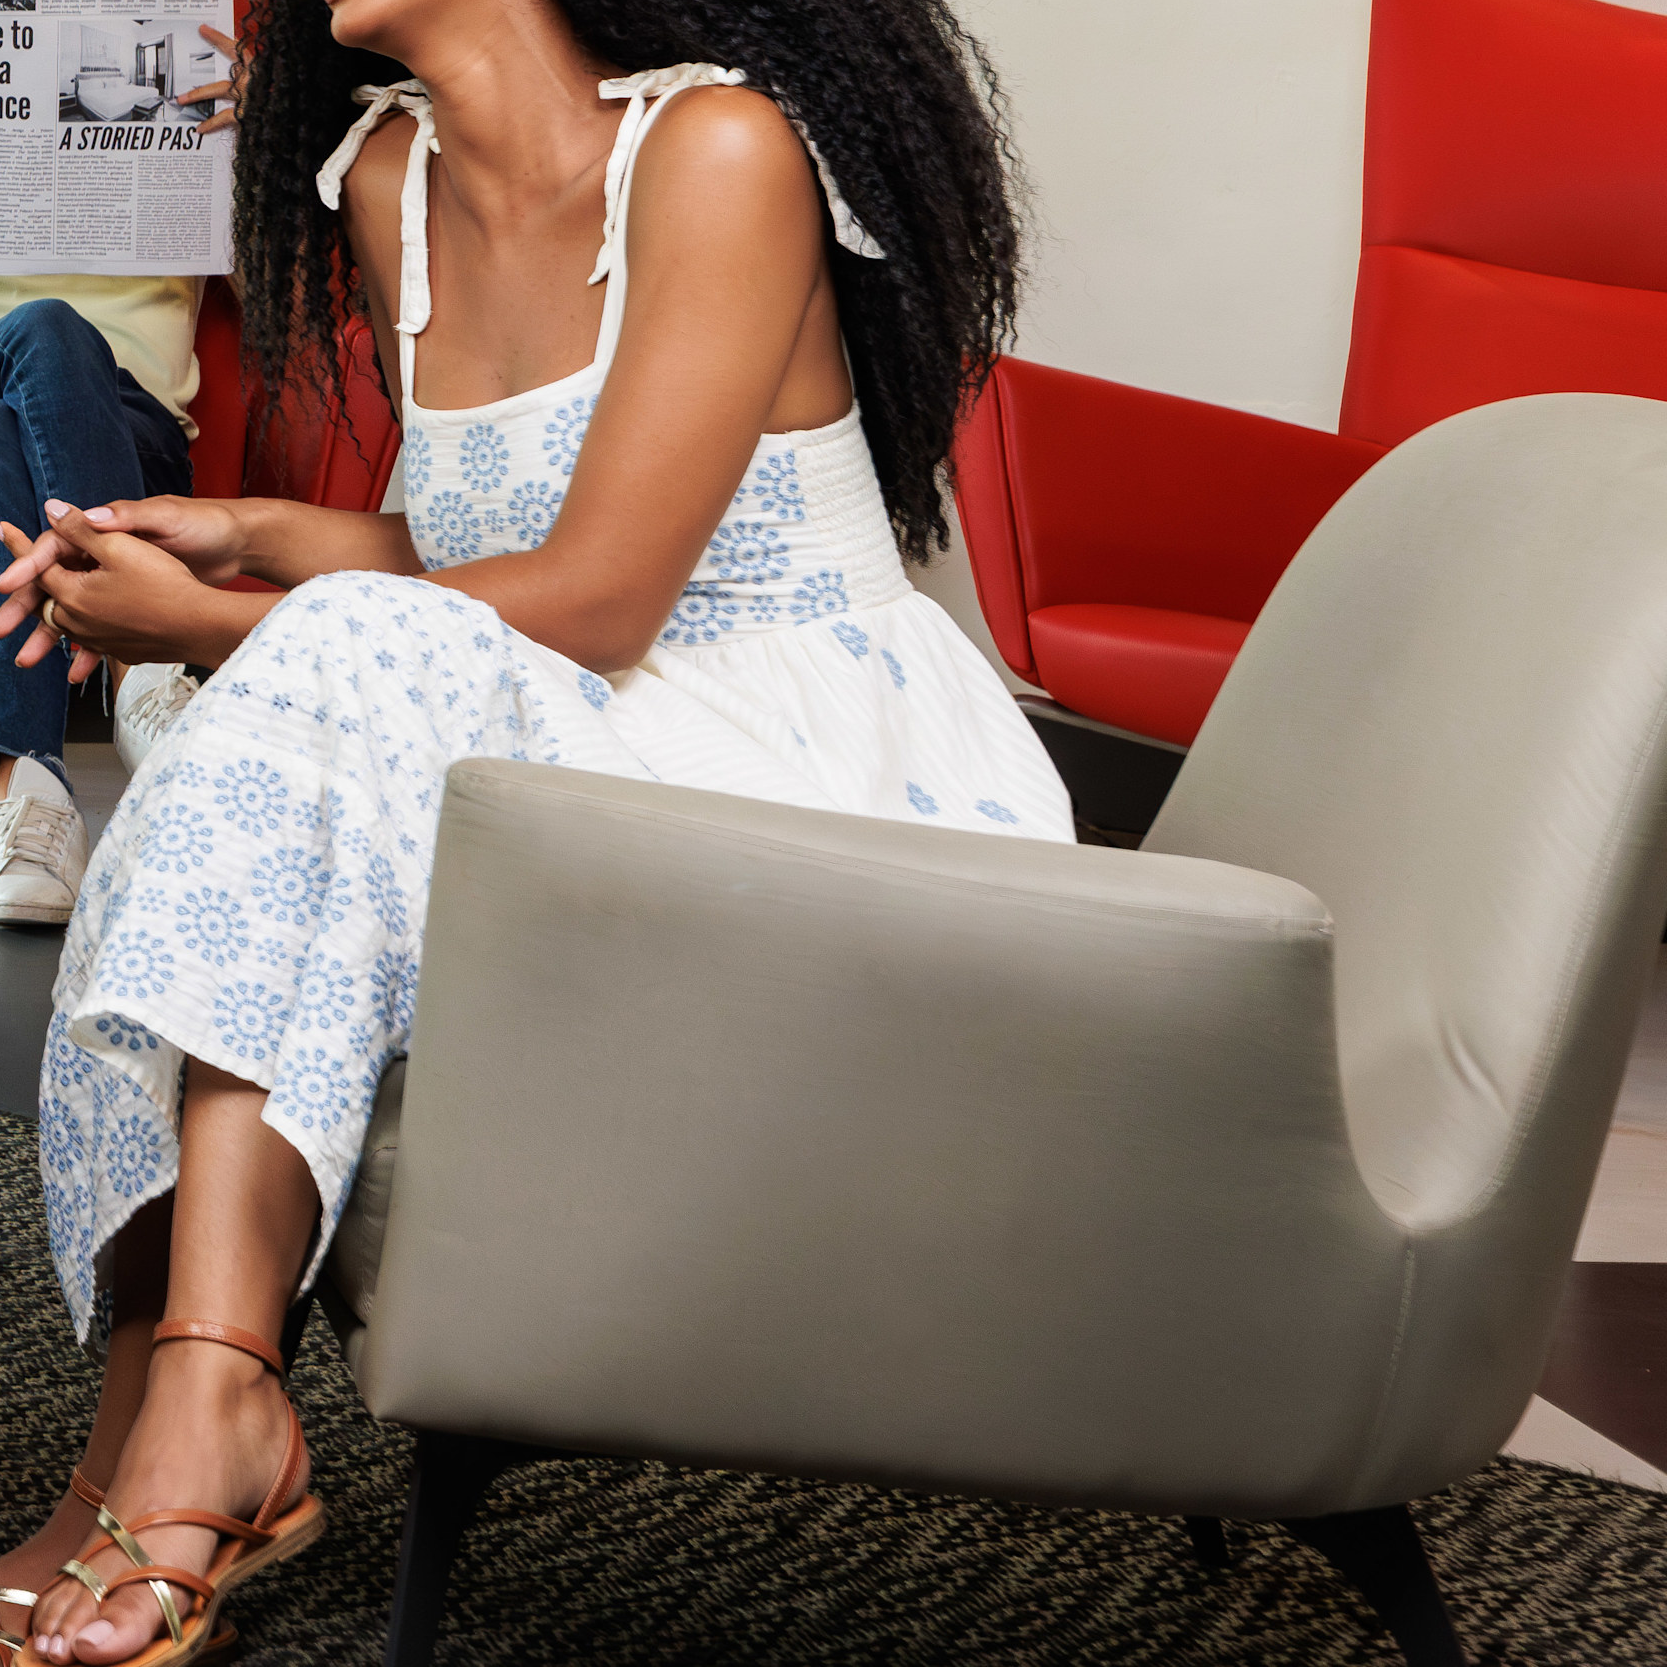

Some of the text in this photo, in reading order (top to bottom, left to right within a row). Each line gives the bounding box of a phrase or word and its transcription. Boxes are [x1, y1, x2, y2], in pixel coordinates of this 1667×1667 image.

[10, 18, 35, 51] to
[58, 126, 204, 151] A STORIED PAST
